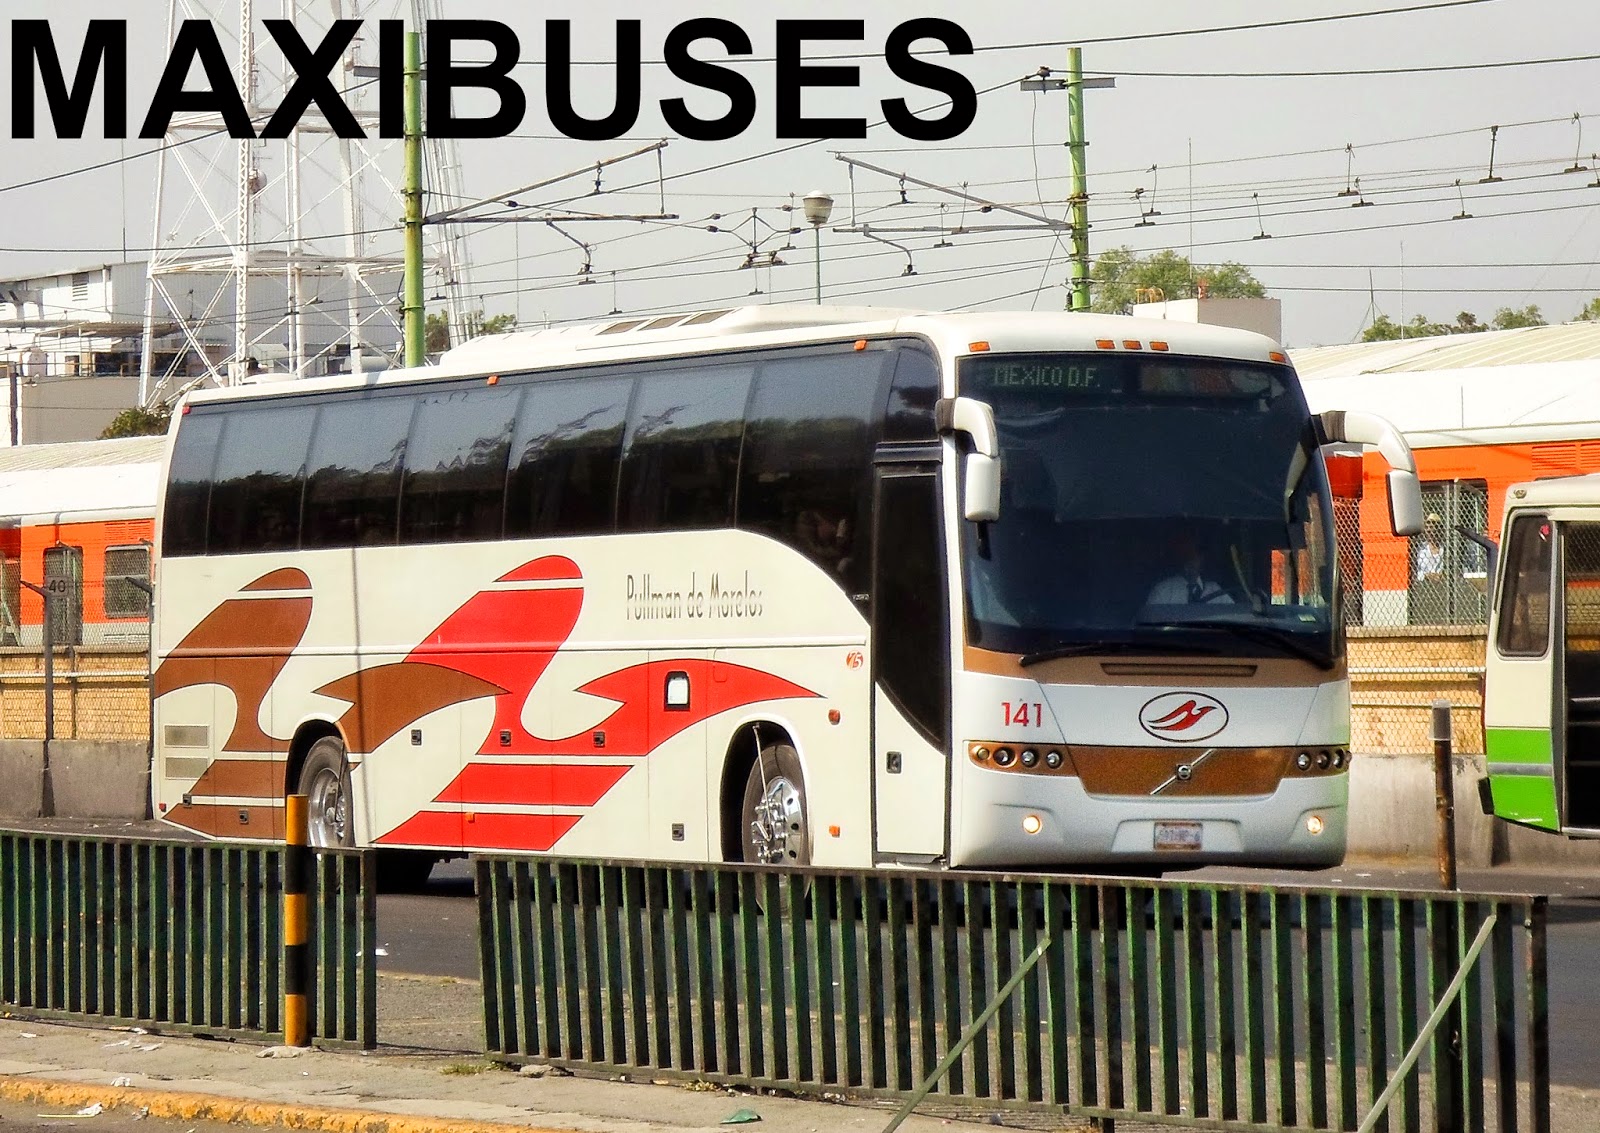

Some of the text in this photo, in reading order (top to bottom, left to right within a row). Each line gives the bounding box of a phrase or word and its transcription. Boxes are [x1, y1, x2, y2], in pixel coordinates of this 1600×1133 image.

[994, 365, 1062, 386] MEXICO
[49, 579, 66, 593] 40
[626, 569, 763, 621] Pullman de Morelos
[1002, 702, 1042, 727] 141
